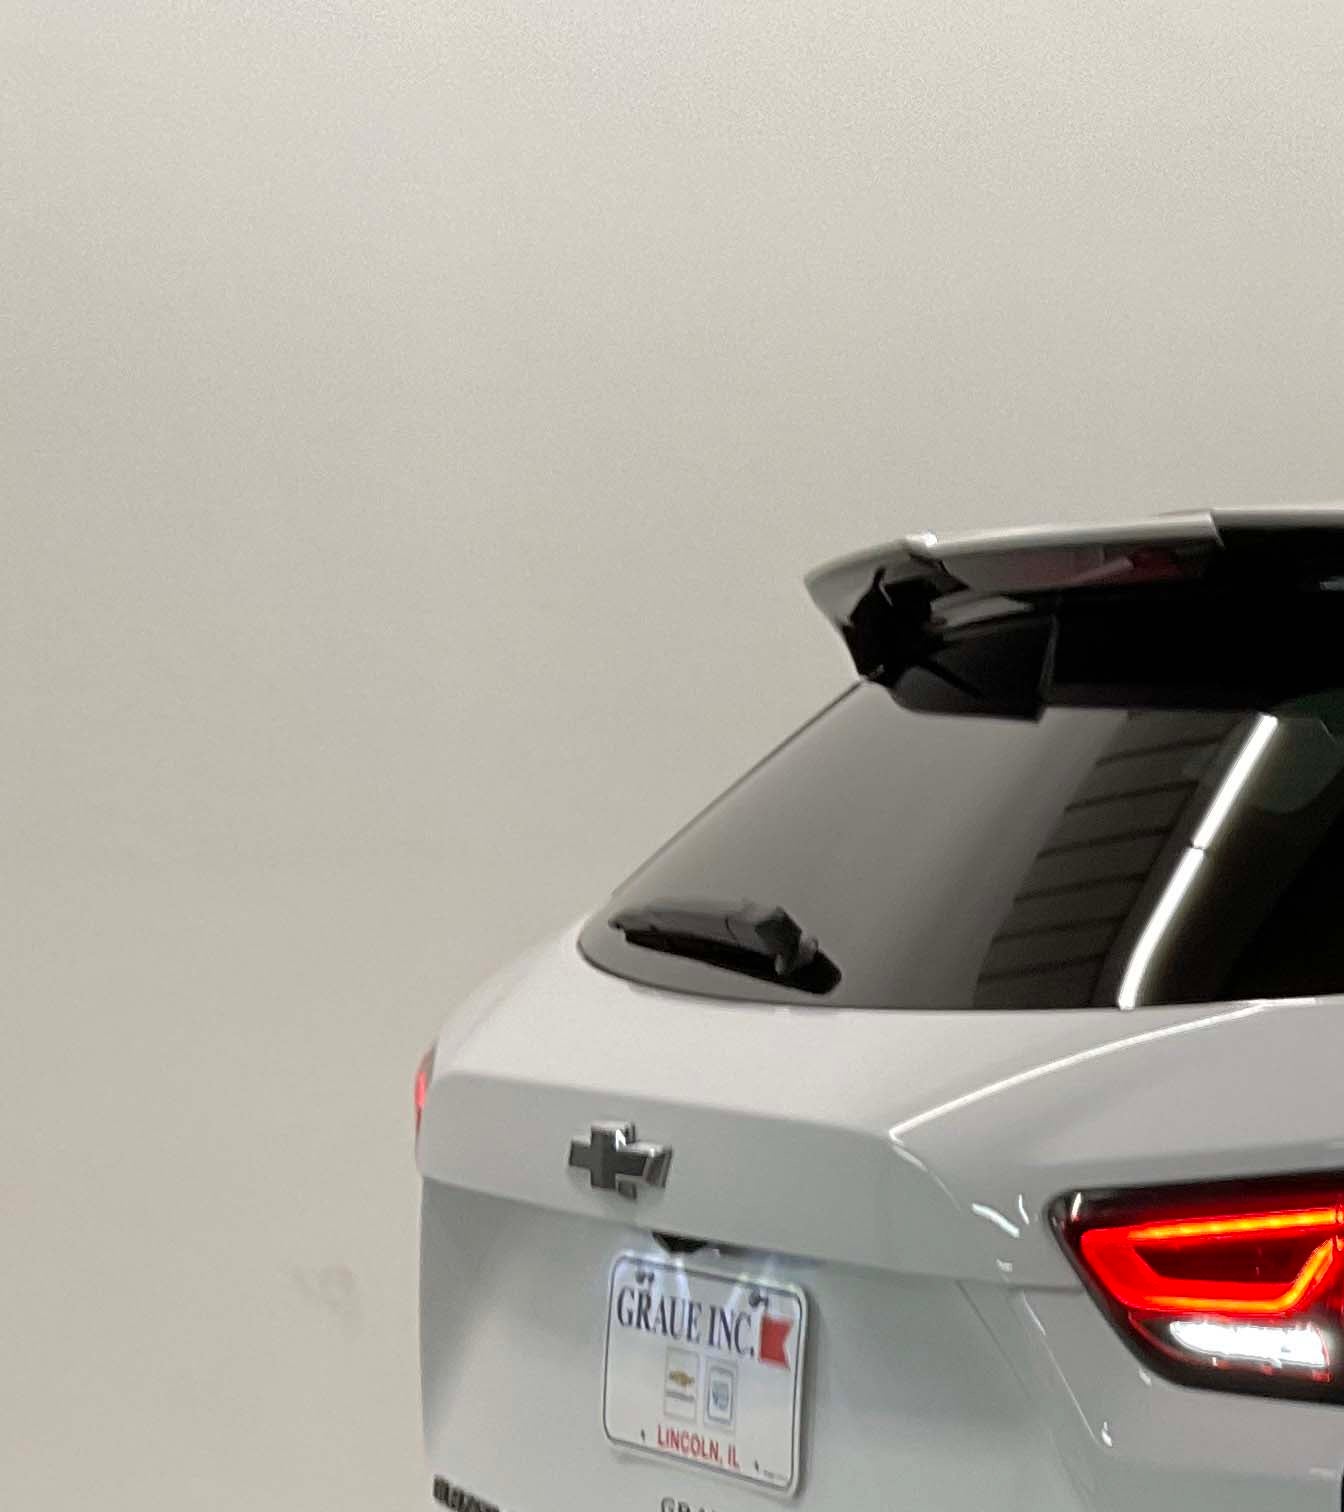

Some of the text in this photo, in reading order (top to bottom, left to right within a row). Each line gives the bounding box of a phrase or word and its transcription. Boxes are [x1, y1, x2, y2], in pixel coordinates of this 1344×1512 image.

[616, 1286, 755, 1357] GRAUE INC.
[657, 1423, 740, 1468] LINCOLN, IL
